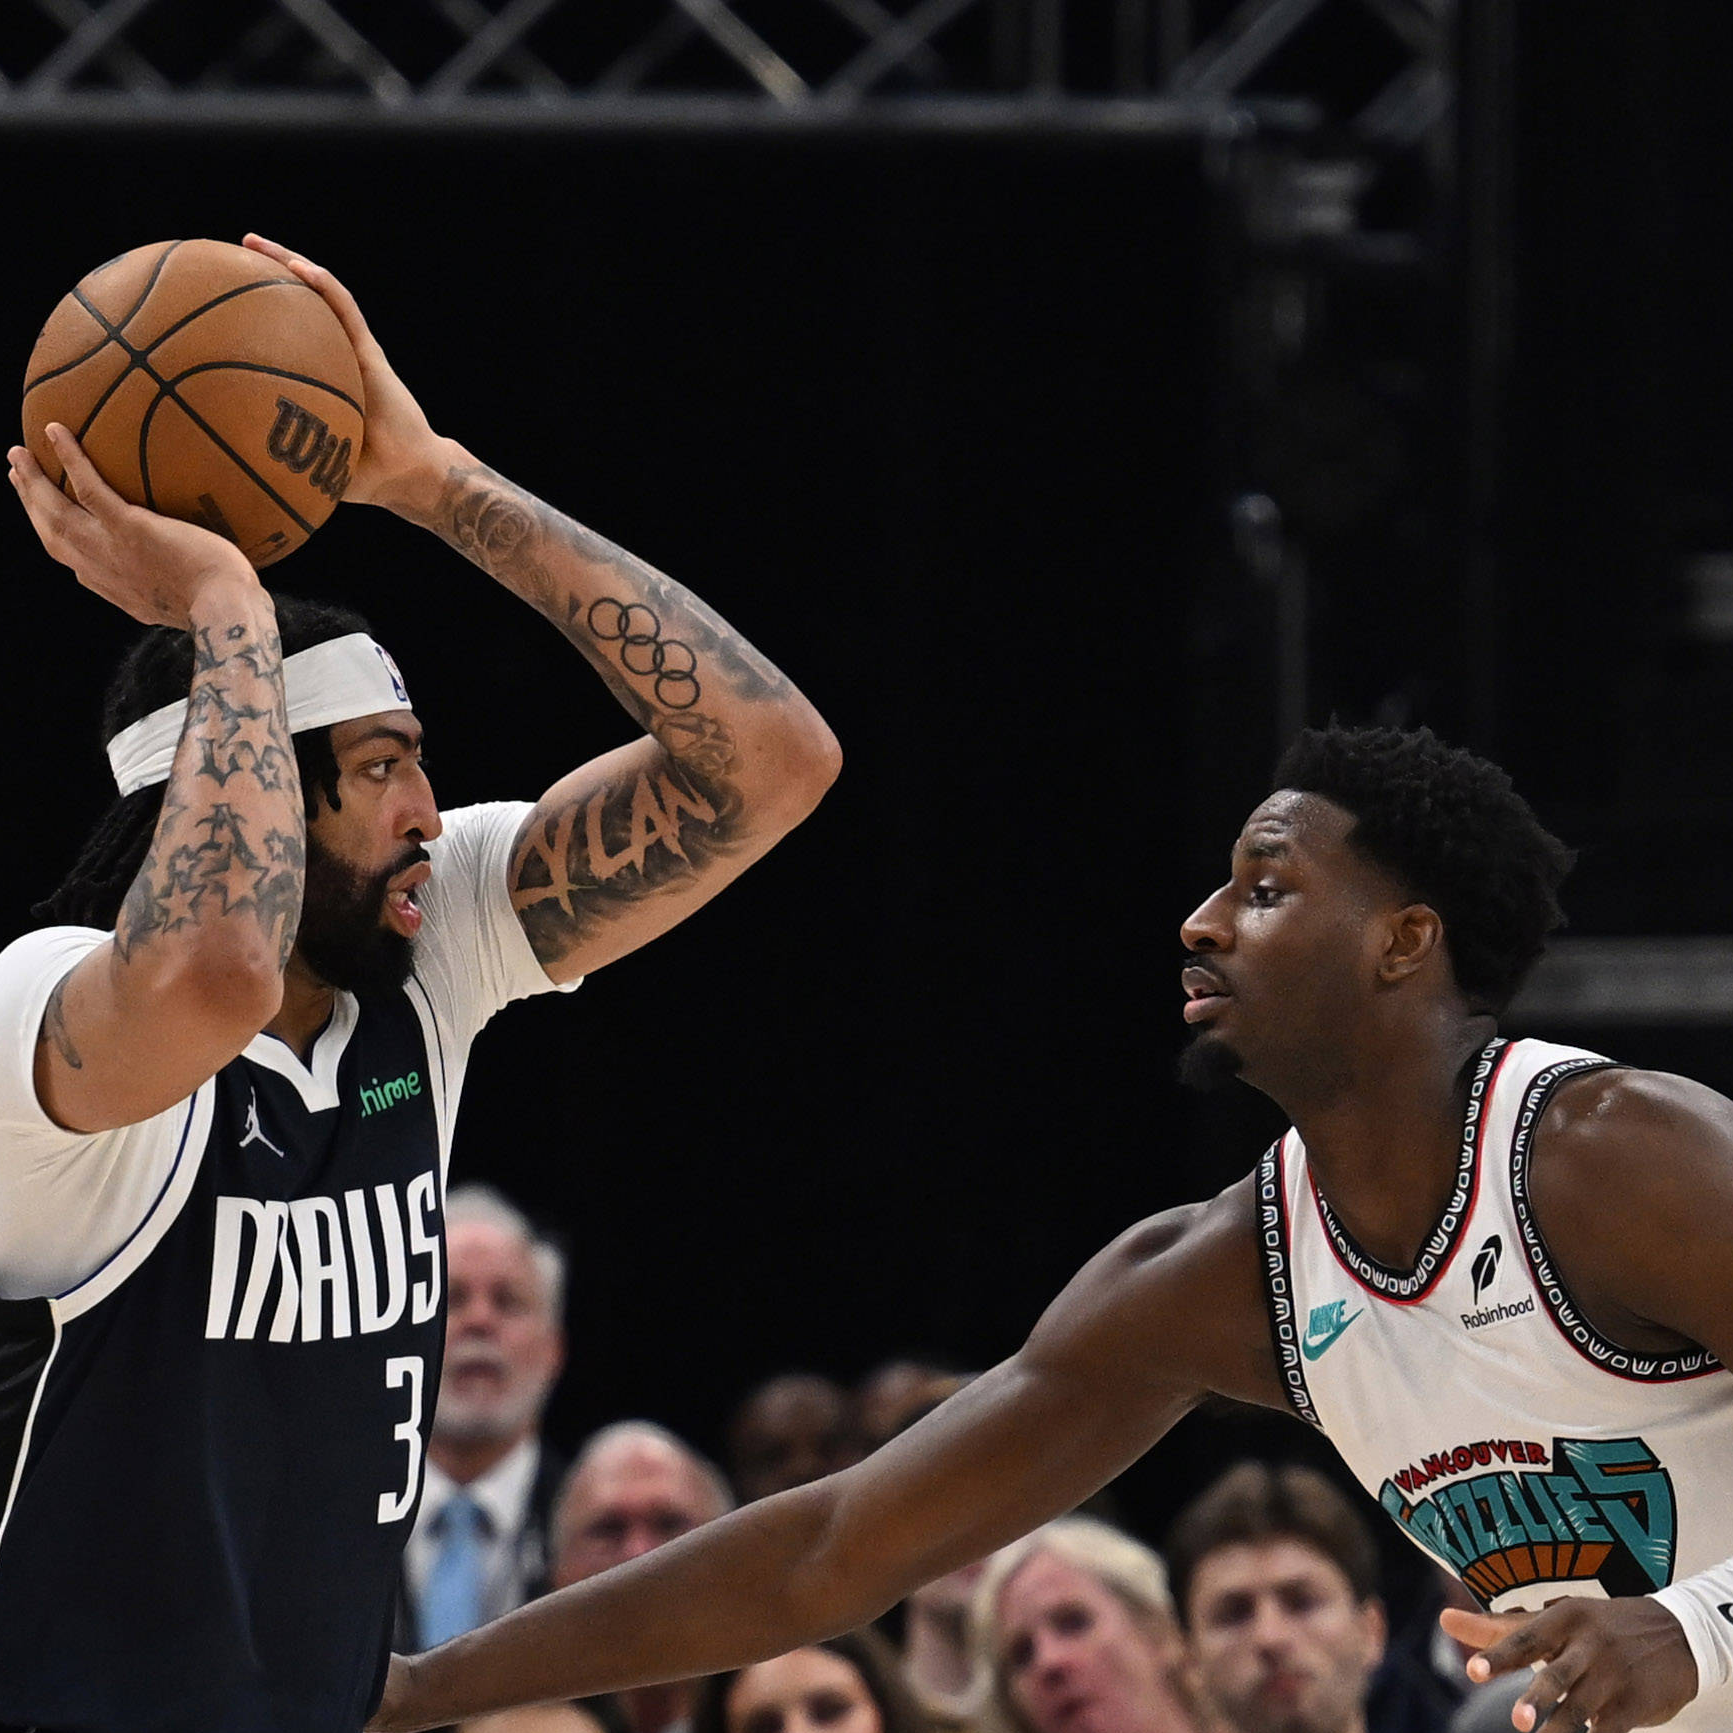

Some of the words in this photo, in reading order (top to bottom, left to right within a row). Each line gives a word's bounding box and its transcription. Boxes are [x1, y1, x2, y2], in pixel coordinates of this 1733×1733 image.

[359, 1071, 422, 1119] hime
[1308, 1299, 1347, 1338] NIKE
[1460, 1294, 1535, 1330] Robinhood
[377, 1356, 424, 1524] 3
[1394, 1438, 1551, 1495] VANCOUVER
[1378, 1437, 1677, 1592] GRIZZLIES
